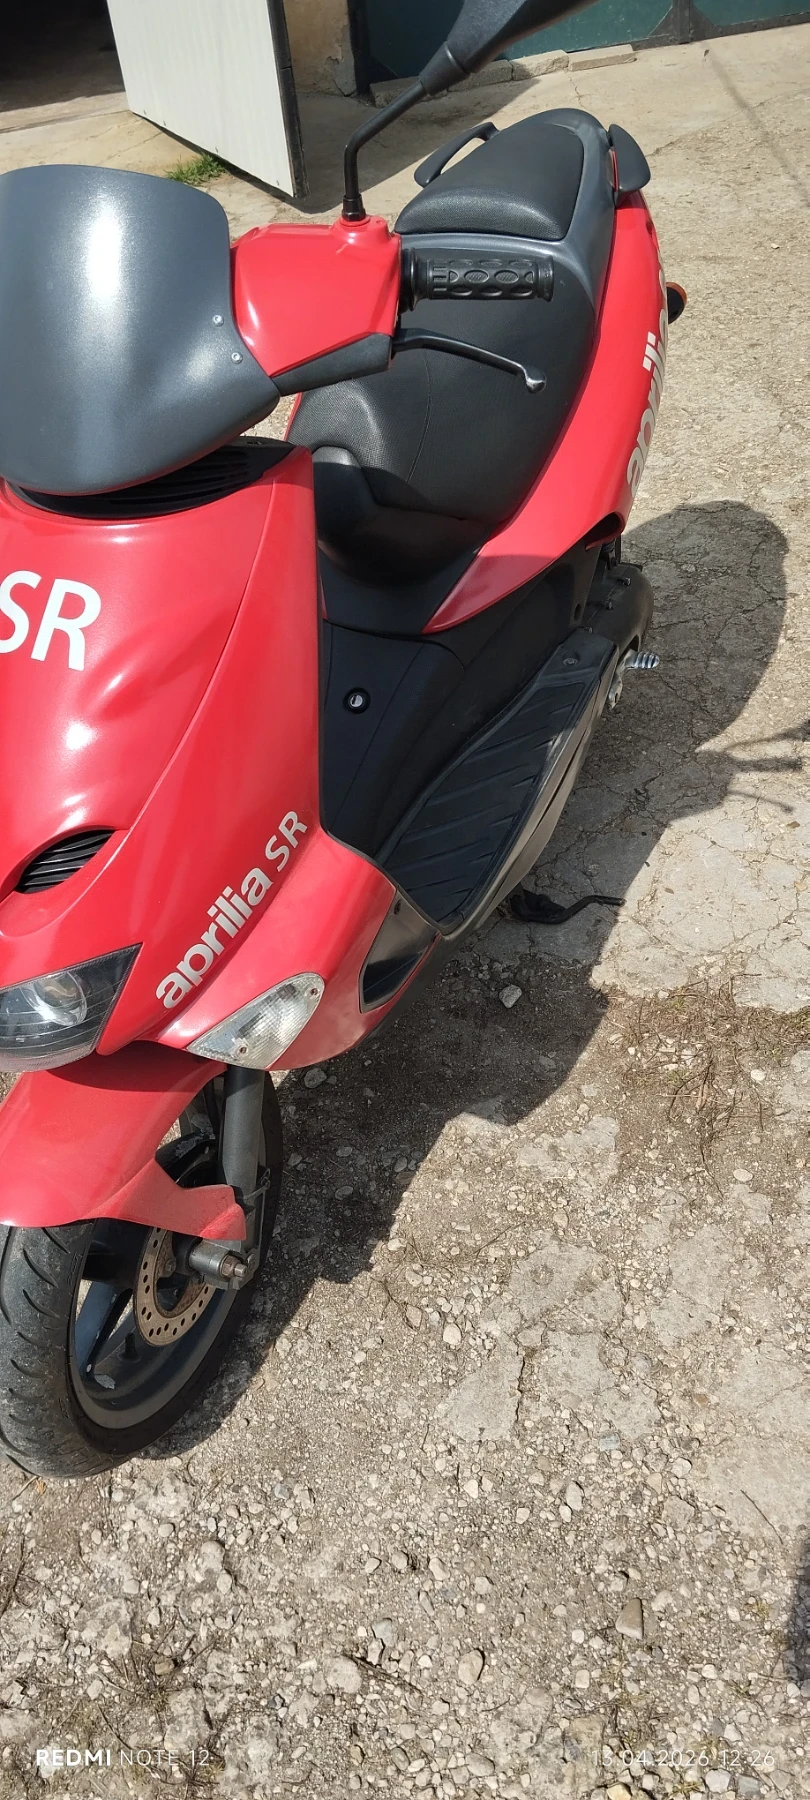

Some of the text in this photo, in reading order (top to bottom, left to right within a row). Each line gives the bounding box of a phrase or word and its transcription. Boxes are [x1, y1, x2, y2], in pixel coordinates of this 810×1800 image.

[0, 570, 102, 672] SR
[155, 811, 308, 1009] aprilia SR
